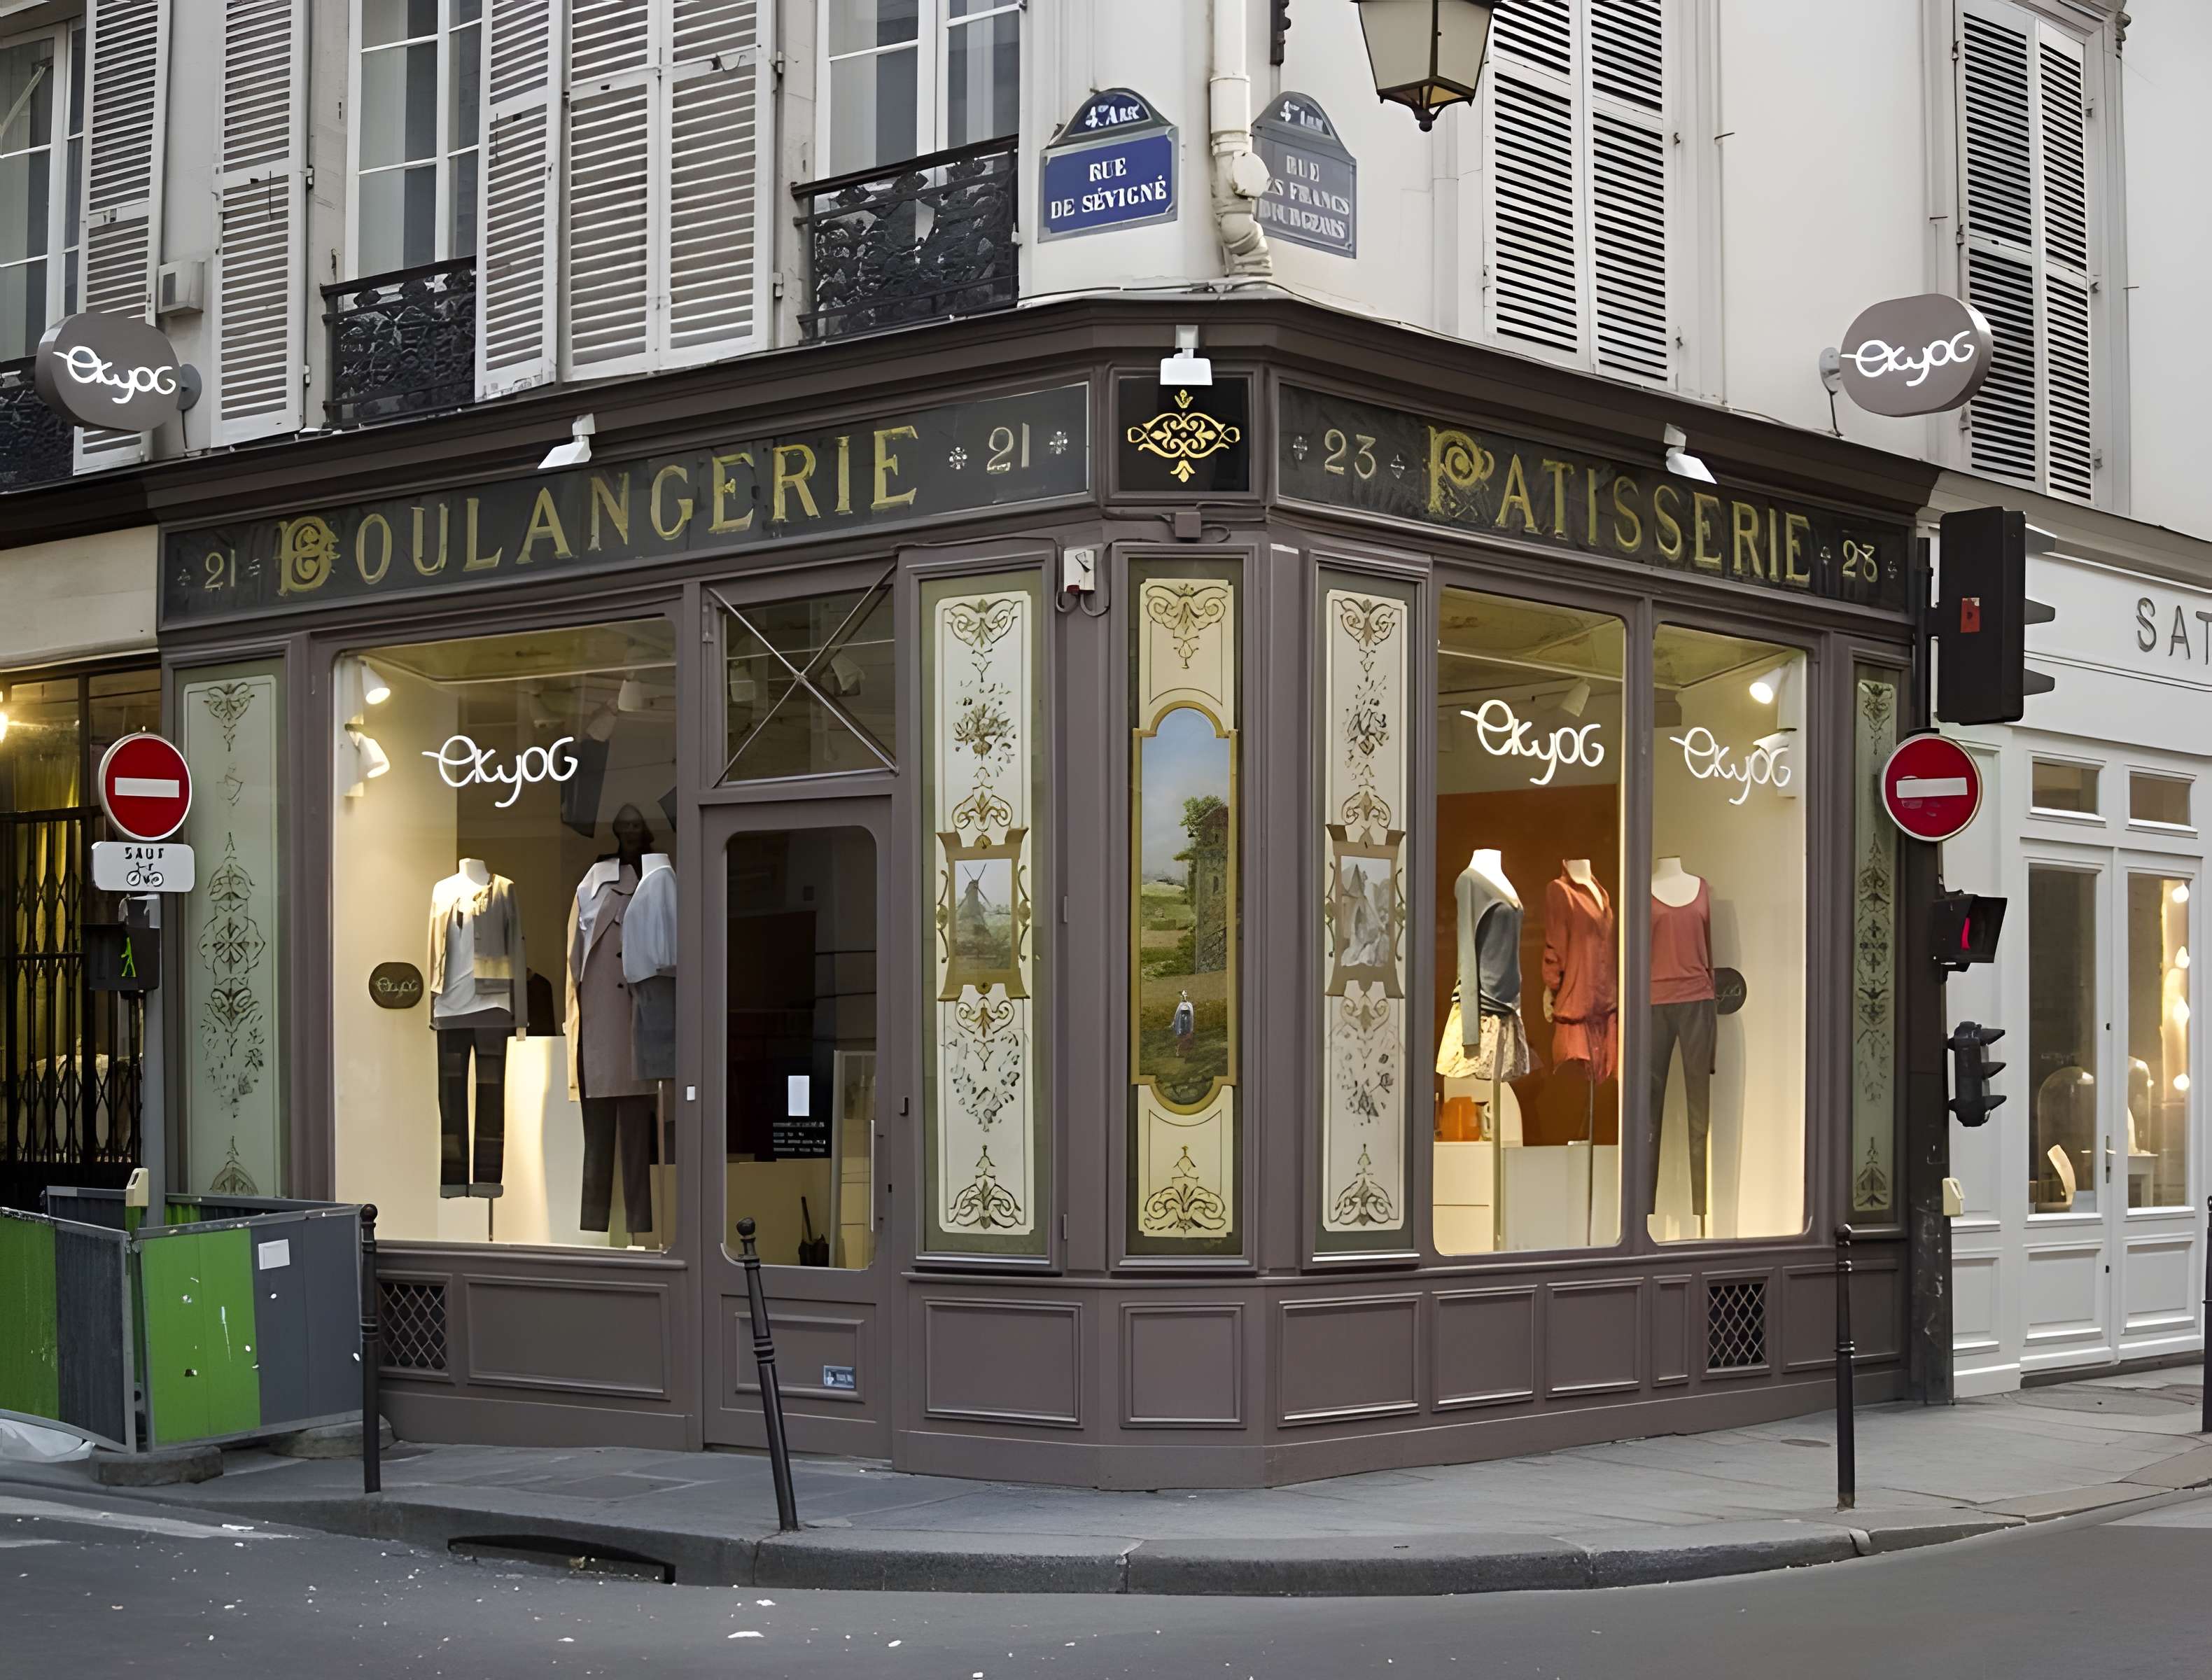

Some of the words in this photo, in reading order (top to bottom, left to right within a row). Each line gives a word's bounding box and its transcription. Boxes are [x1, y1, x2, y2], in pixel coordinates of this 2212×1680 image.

[1051, 198, 1075, 219] DE
[1089, 158, 1126, 182] RUE
[204, 549, 235, 591] 21
[277, 424, 919, 596] BOULANGERIE
[986, 422, 1030, 475] 21
[1324, 428, 1377, 479] 23
[1427, 425, 1811, 587] PATISSERIE
